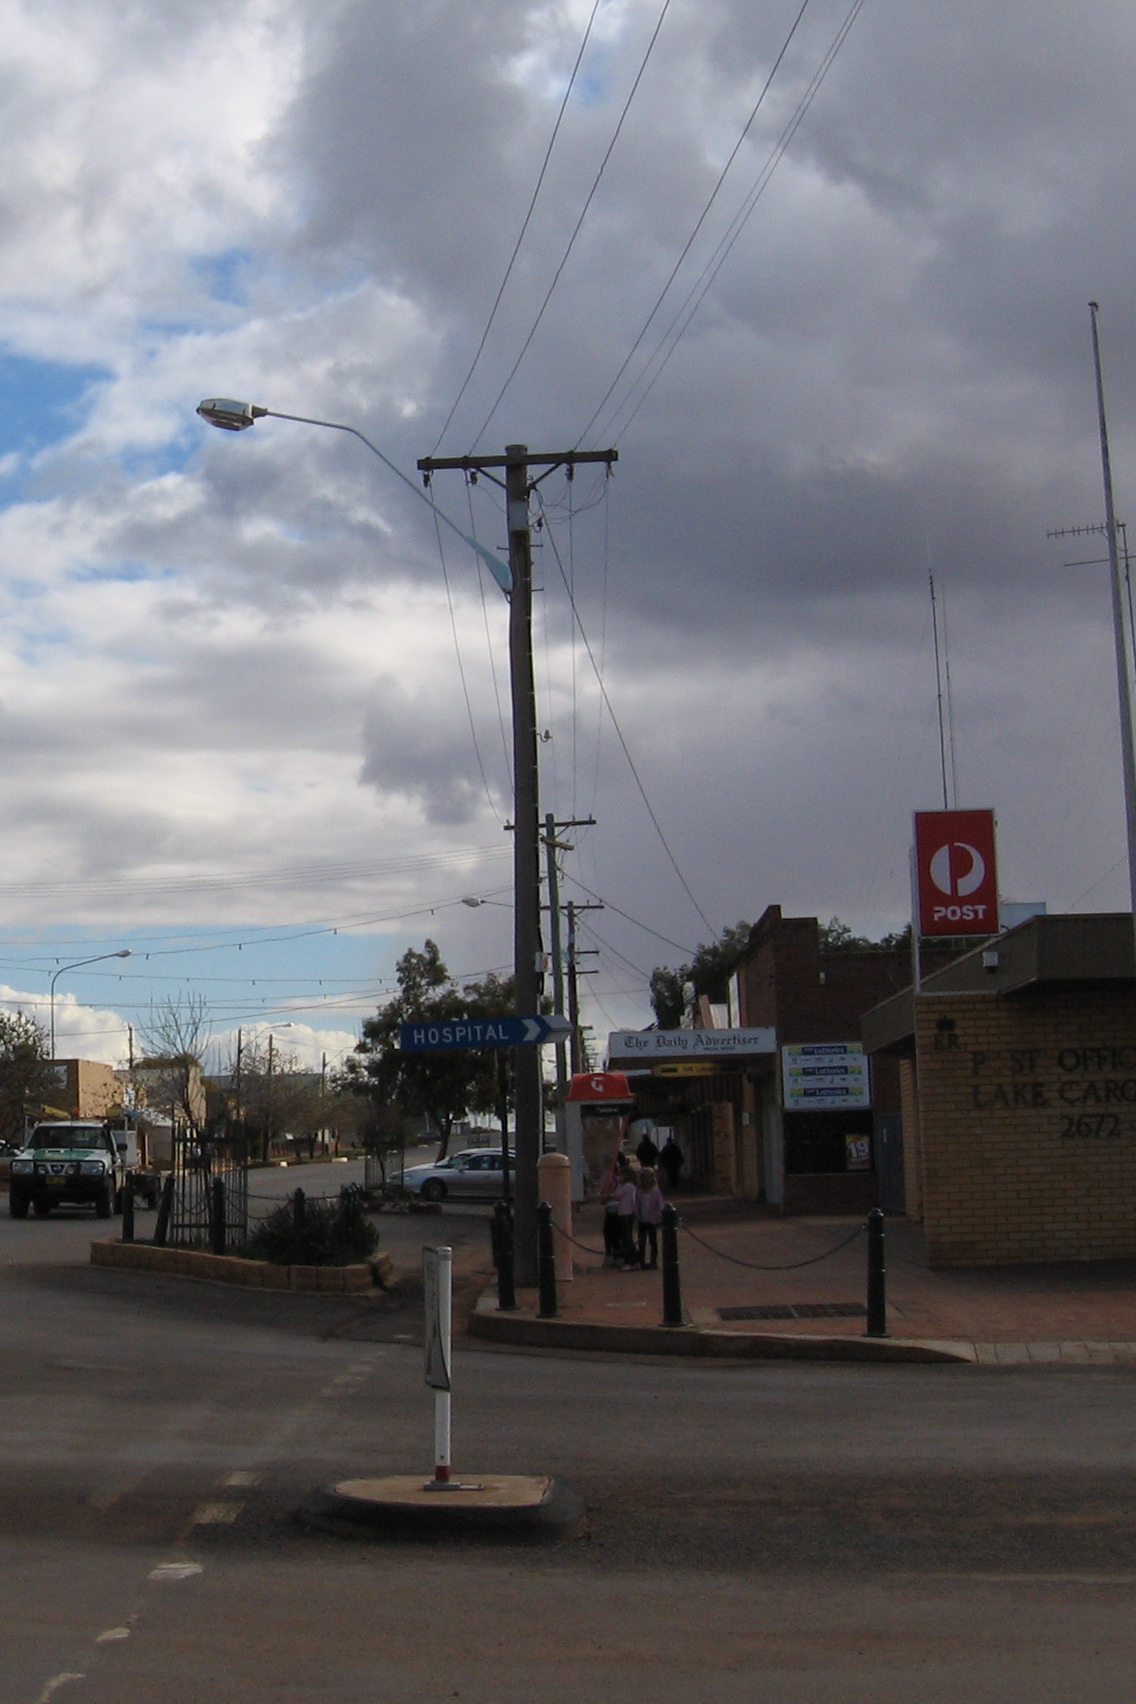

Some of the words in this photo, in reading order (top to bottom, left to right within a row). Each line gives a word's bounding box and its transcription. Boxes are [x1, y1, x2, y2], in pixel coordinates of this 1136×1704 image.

[933, 905, 987, 921] POST
[413, 1025, 509, 1045] HOSPITAL
[624, 1036, 648, 1050] The
[656, 1035, 688, 1050] Daily
[693, 1034, 759, 1048] Advertiser
[972, 1050, 1041, 1075] PST
[973, 1082, 1049, 1108] LAKE
[1061, 1114, 1121, 1138] 2672
